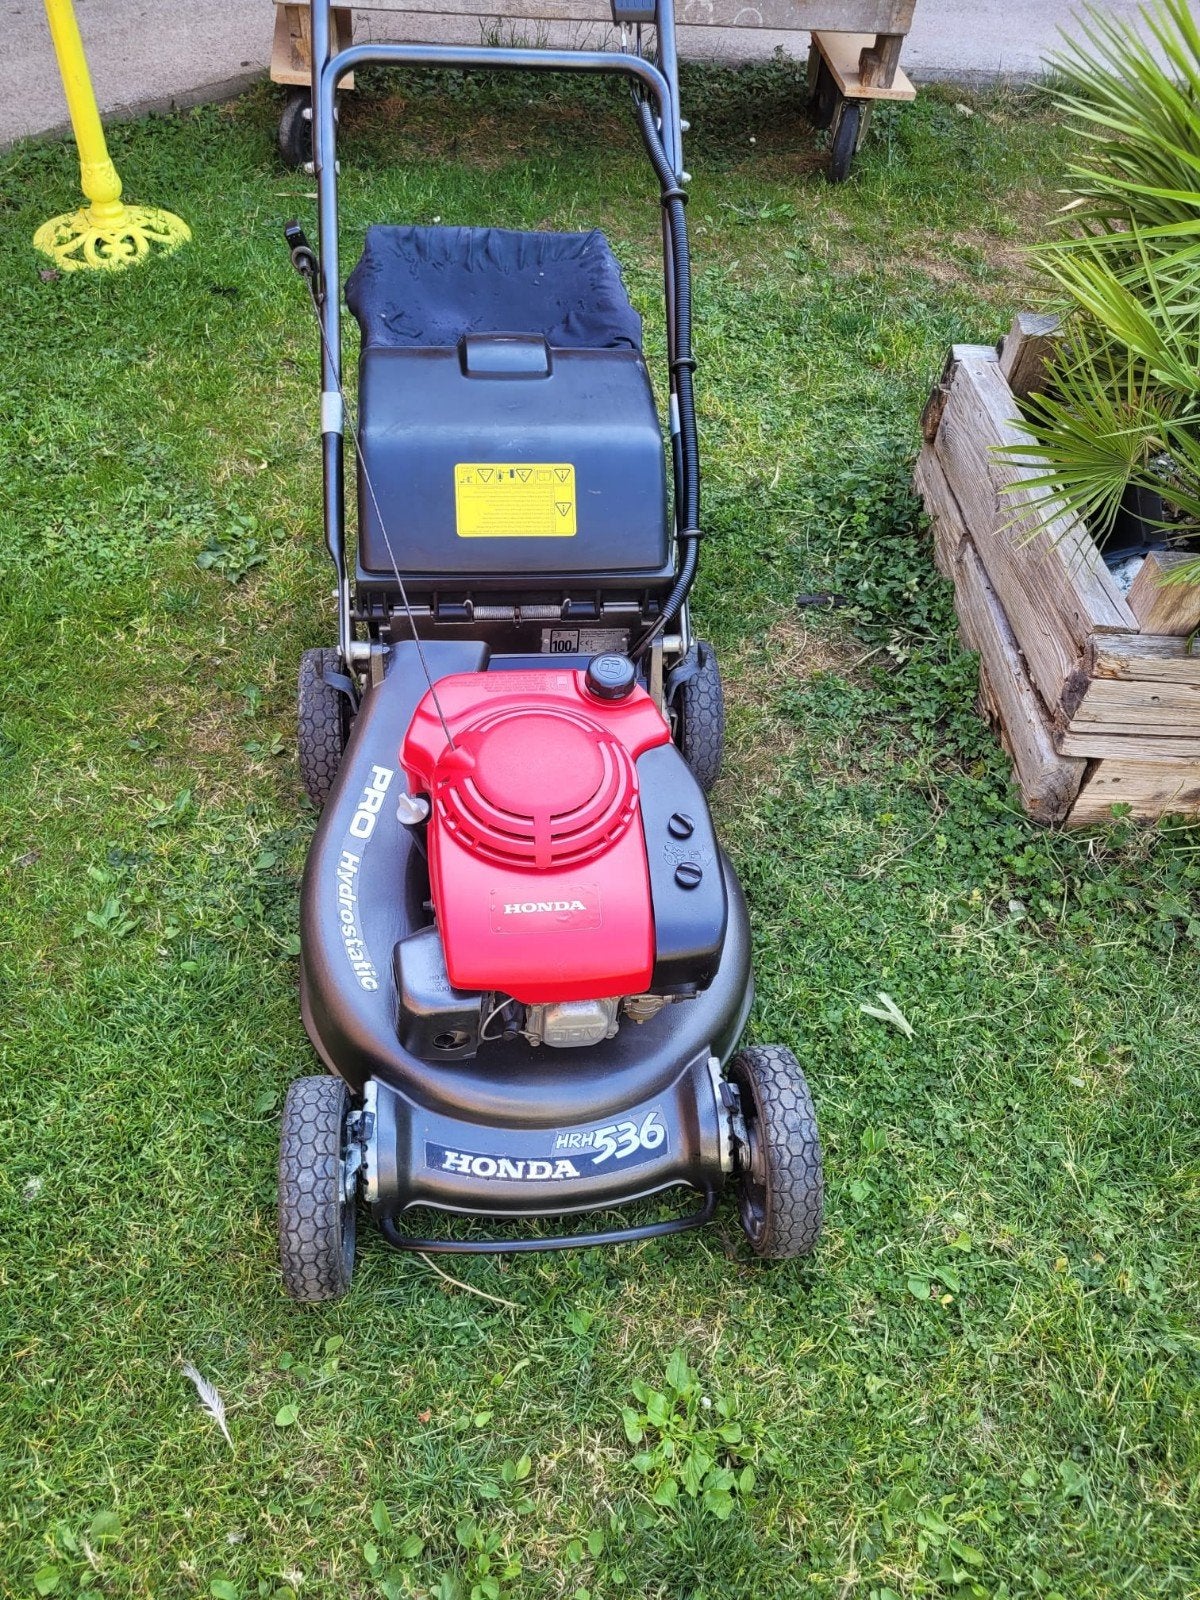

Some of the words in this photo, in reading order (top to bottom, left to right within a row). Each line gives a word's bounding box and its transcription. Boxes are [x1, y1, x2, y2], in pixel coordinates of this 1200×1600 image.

[552, 640, 572, 652] 100
[349, 765, 393, 839] PRO
[337, 851, 378, 992] Hydrostatic
[504, 901, 586, 914] HONDA
[442, 1150, 581, 1179] HONDA
